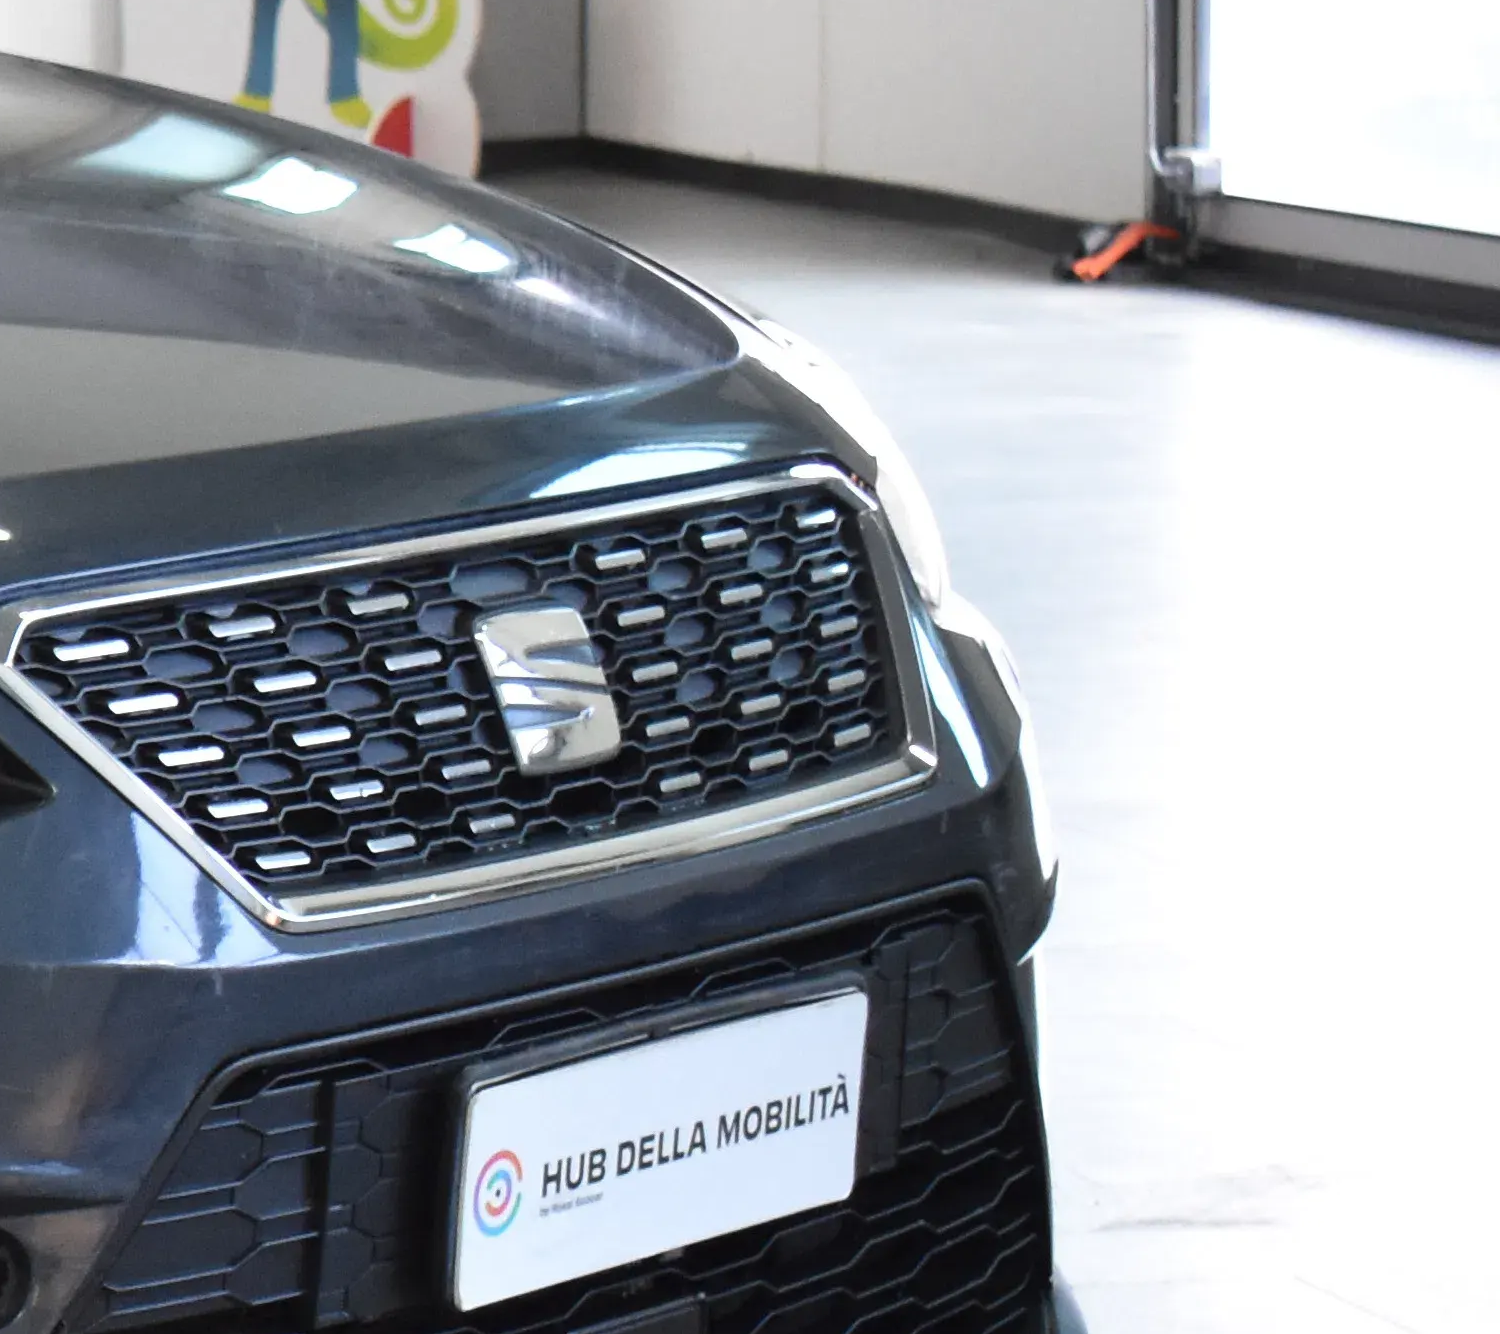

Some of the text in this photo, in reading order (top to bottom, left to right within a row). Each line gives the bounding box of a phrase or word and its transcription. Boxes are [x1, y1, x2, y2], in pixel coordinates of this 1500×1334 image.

[542, 1073, 850, 1197] HUB DELLA MOBILITÀ
